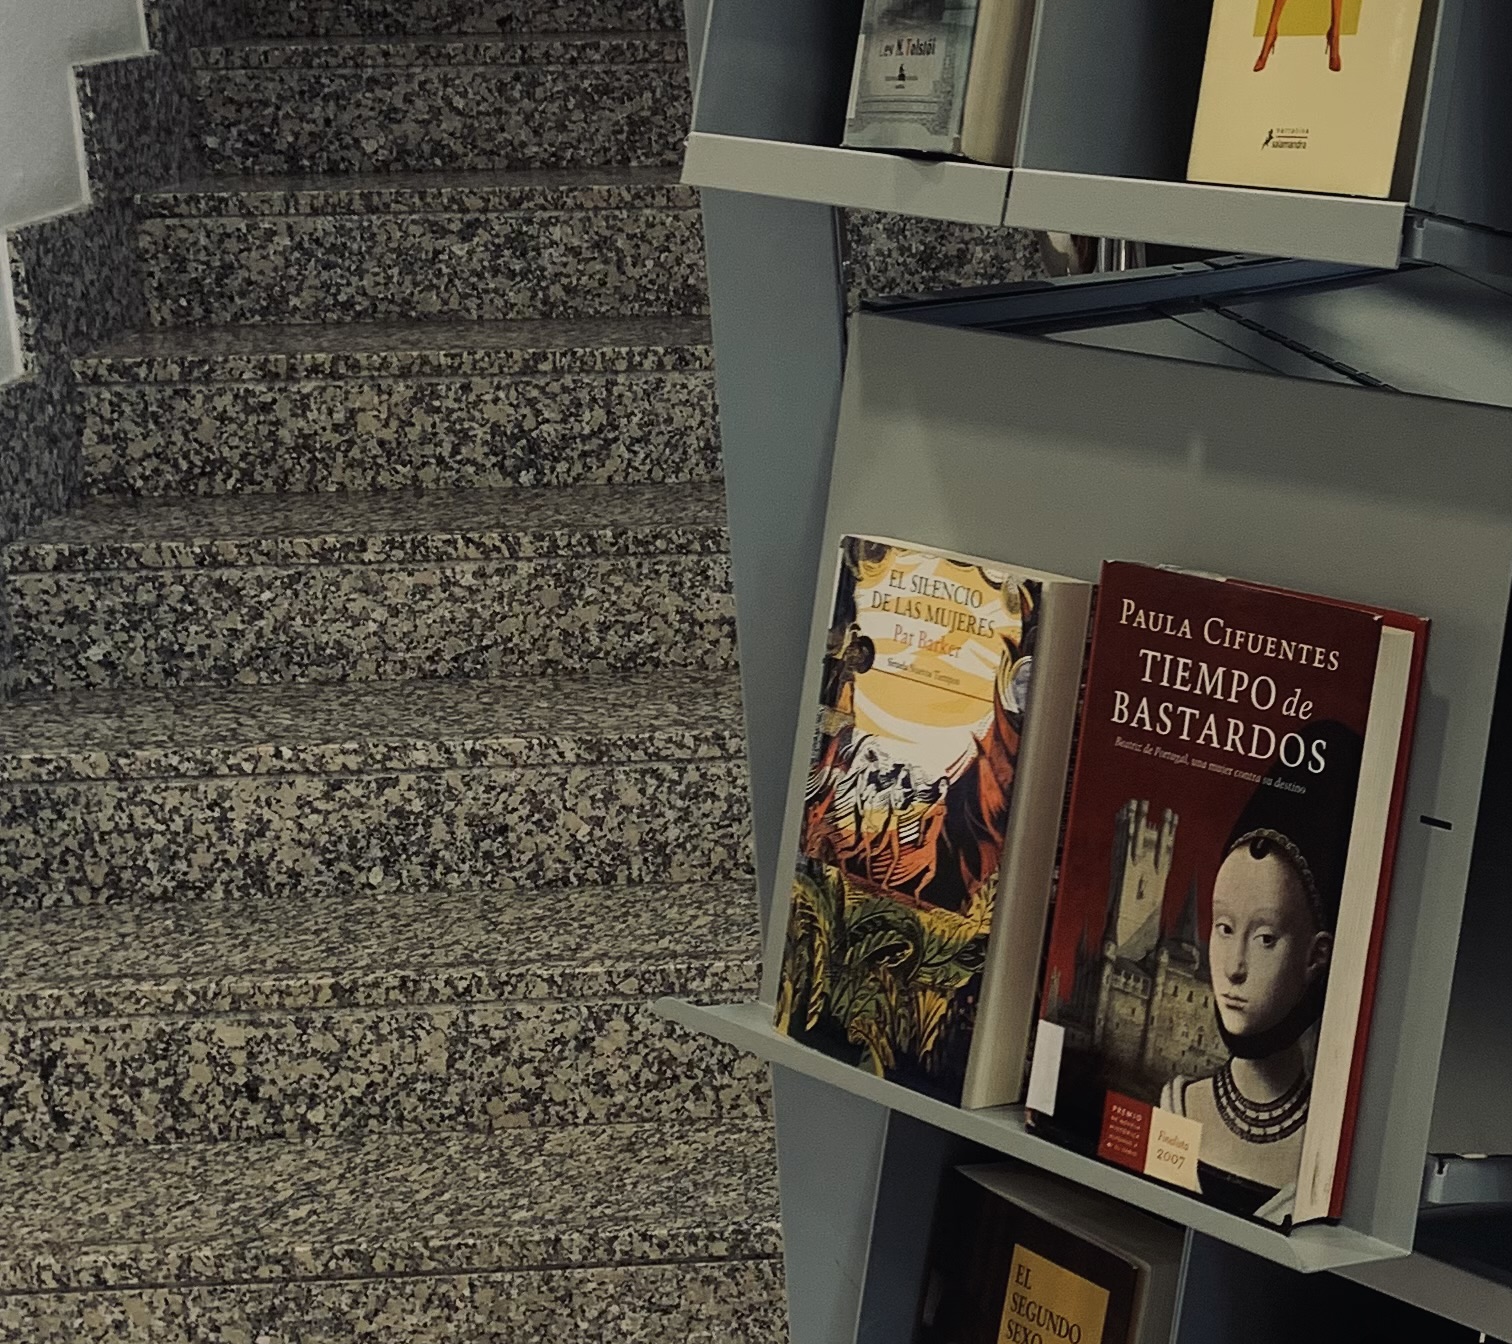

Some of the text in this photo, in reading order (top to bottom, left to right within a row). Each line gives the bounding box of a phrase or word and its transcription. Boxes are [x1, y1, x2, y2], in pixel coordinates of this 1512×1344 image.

[889, 569, 983, 608] EL SILENCIO
[871, 590, 995, 638] DE LAS MUJERES
[1119, 598, 1340, 671] PAULA CIFUENTES
[893, 623, 962, 658] Pat Barker
[1139, 649, 1314, 721] TIEMPO de
[1110, 690, 1327, 774] BASTARDOS
[1114, 736, 1142, 753] Beatriz
[1143, 744, 1153, 756] de
[1191, 758, 1207, 770] una
[1208, 762, 1234, 777] mujer
[1233, 769, 1261, 784] contra
[1262, 776, 1273, 787] su
[1273, 776, 1307, 795] destino
[1156, 1148, 1186, 1170] 2007
[1015, 1263, 1032, 1291] EL
